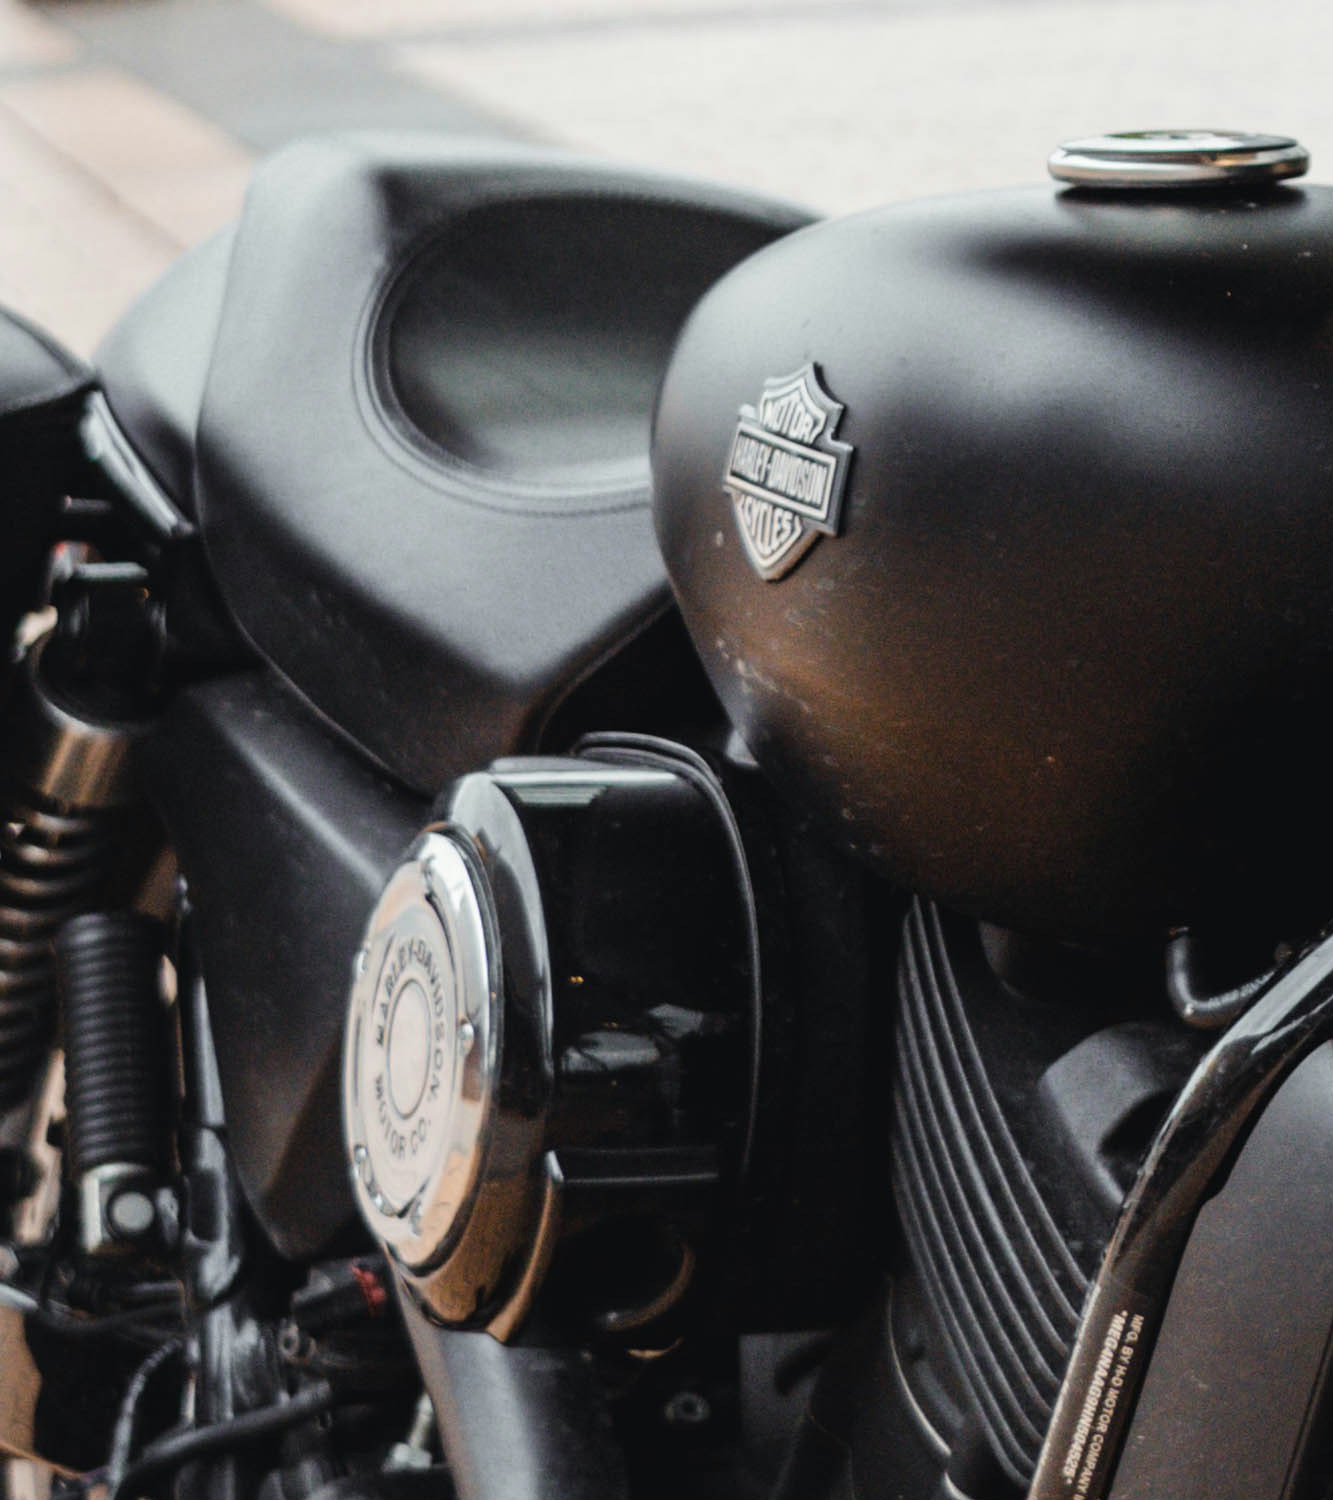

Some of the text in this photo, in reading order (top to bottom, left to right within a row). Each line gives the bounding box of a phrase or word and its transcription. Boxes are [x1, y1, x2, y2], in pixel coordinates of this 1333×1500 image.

[763, 395, 817, 444] MOTOR
[731, 434, 828, 506] HARLEY-DAVIDSON
[1110, 1364, 1128, 1387] H-D
[1119, 1346, 1134, 1364] BY
[1096, 1387, 1121, 1434] MOTOR
[1076, 1433, 1105, 1493] COMPANY
